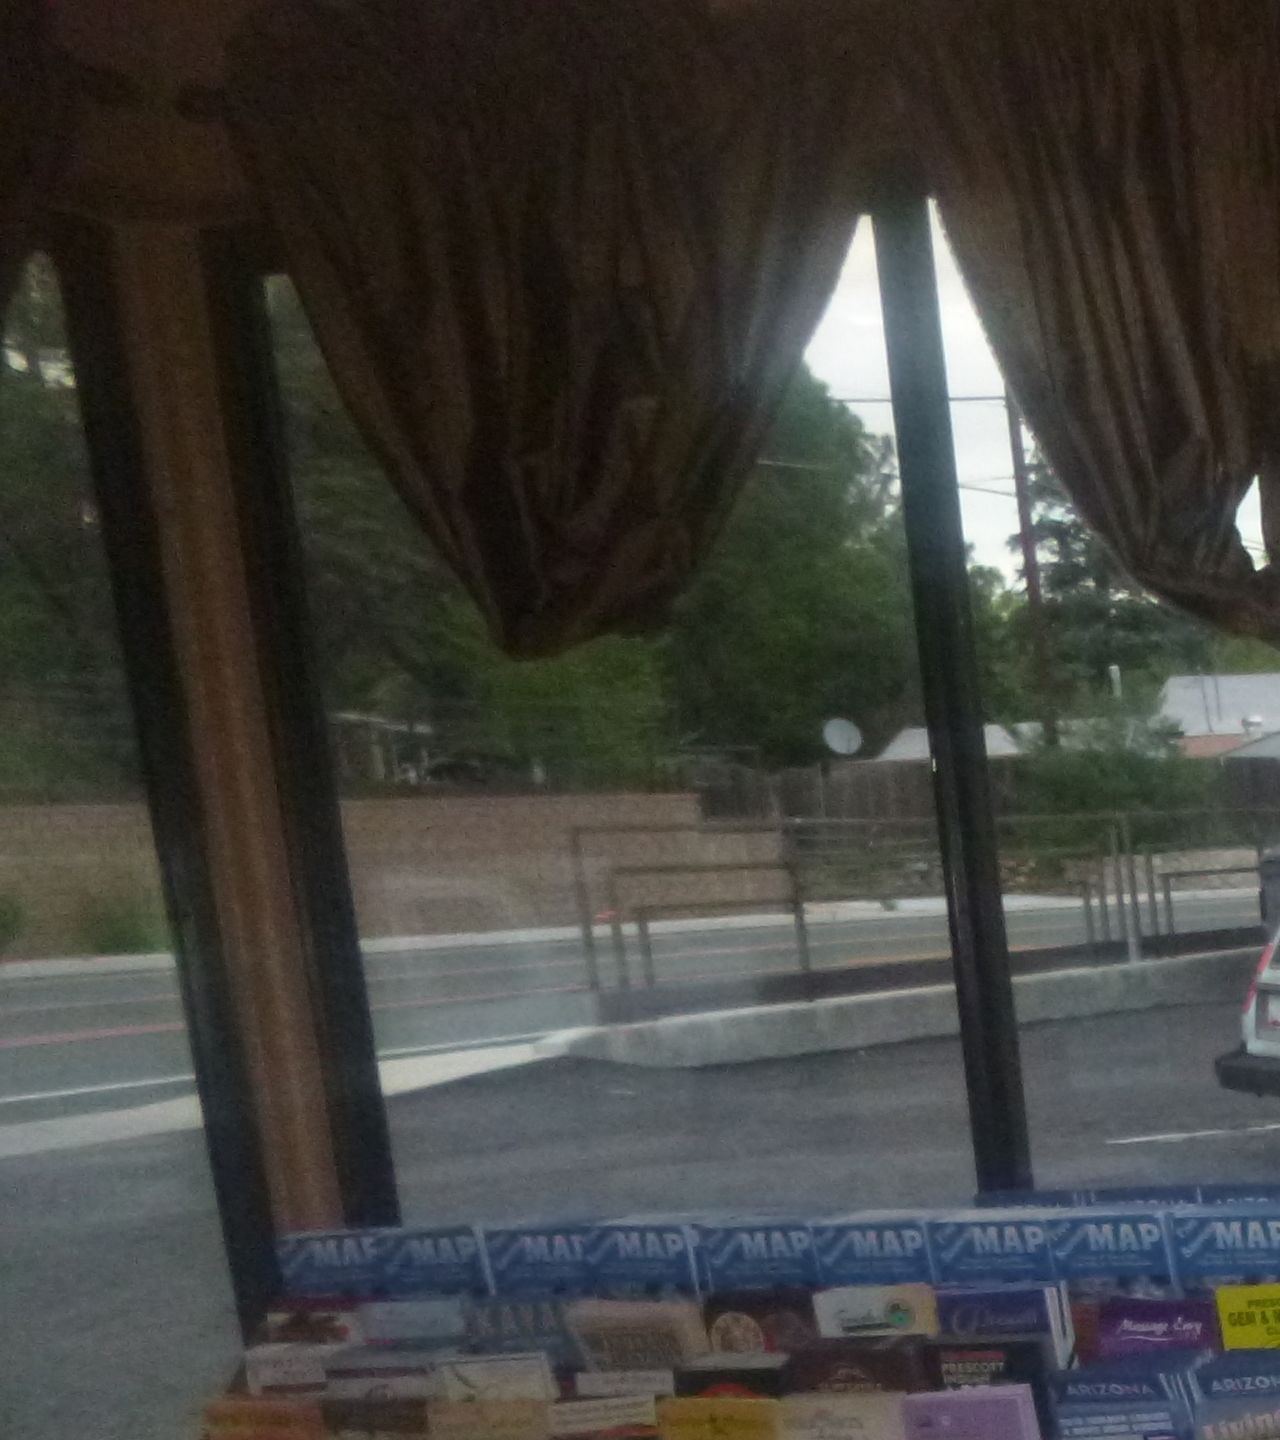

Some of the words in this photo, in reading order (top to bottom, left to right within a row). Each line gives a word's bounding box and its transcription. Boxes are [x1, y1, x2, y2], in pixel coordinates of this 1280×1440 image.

[617, 1231, 691, 1260] MAP
[743, 1230, 810, 1259] MAP
[854, 1227, 924, 1258] MAP
[973, 1224, 1045, 1254] MAP
[1087, 1222, 1161, 1252] MAP
[1227, 1312, 1258, 1328] GEM
[1066, 1382, 1155, 1398] ARIZONA
